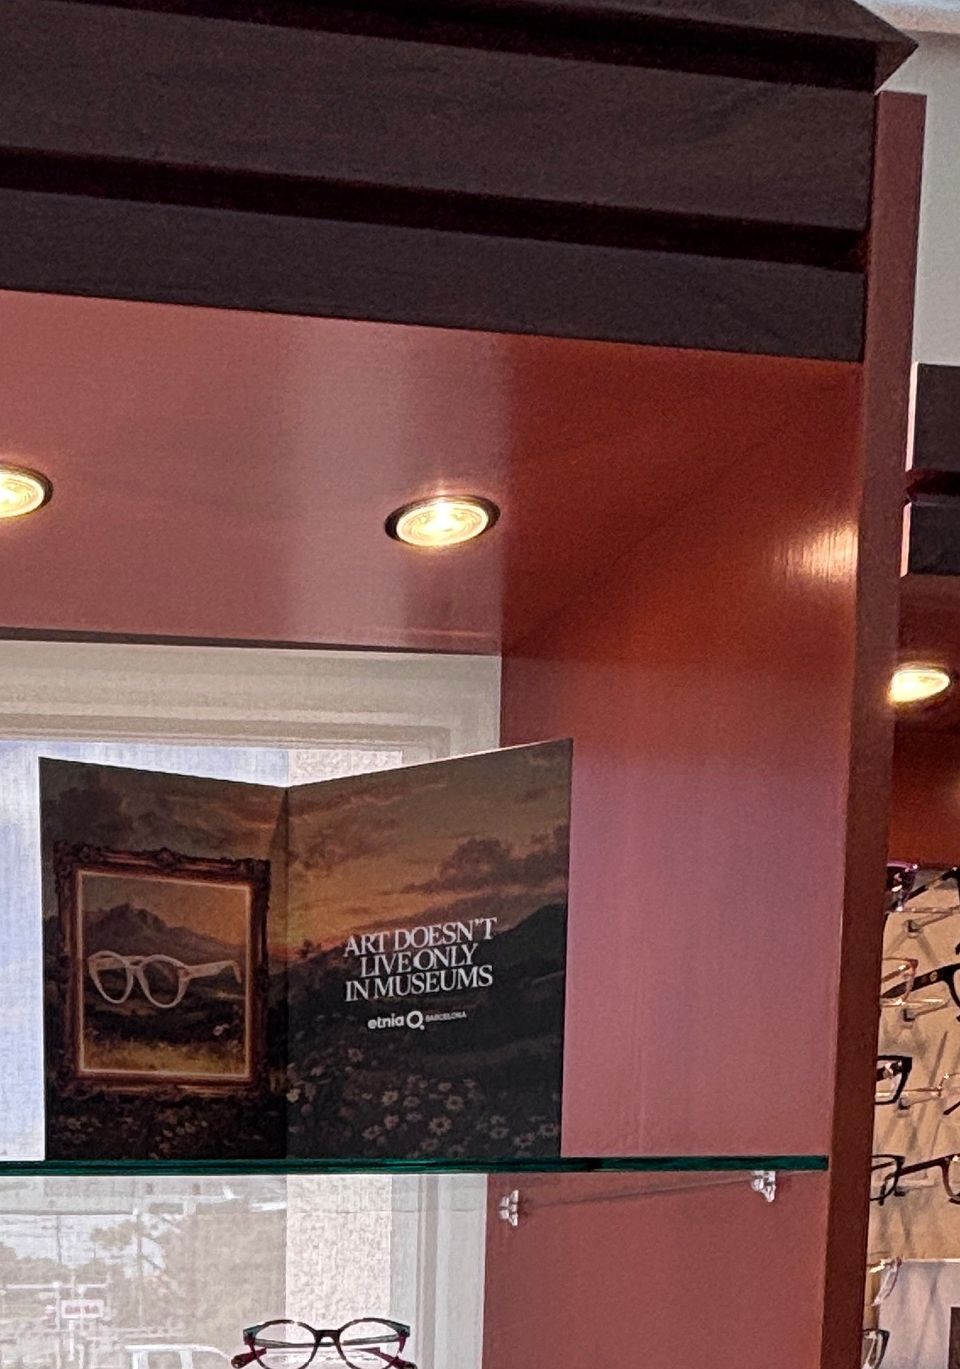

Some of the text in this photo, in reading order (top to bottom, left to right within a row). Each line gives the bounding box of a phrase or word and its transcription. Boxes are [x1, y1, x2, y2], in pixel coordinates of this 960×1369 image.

[342, 917, 498, 957] ART DOESN'T
[360, 943, 479, 978] LIVE ONLY
[345, 964, 494, 1002] IN MUSEUMS
[367, 1012, 405, 1029] etnia
